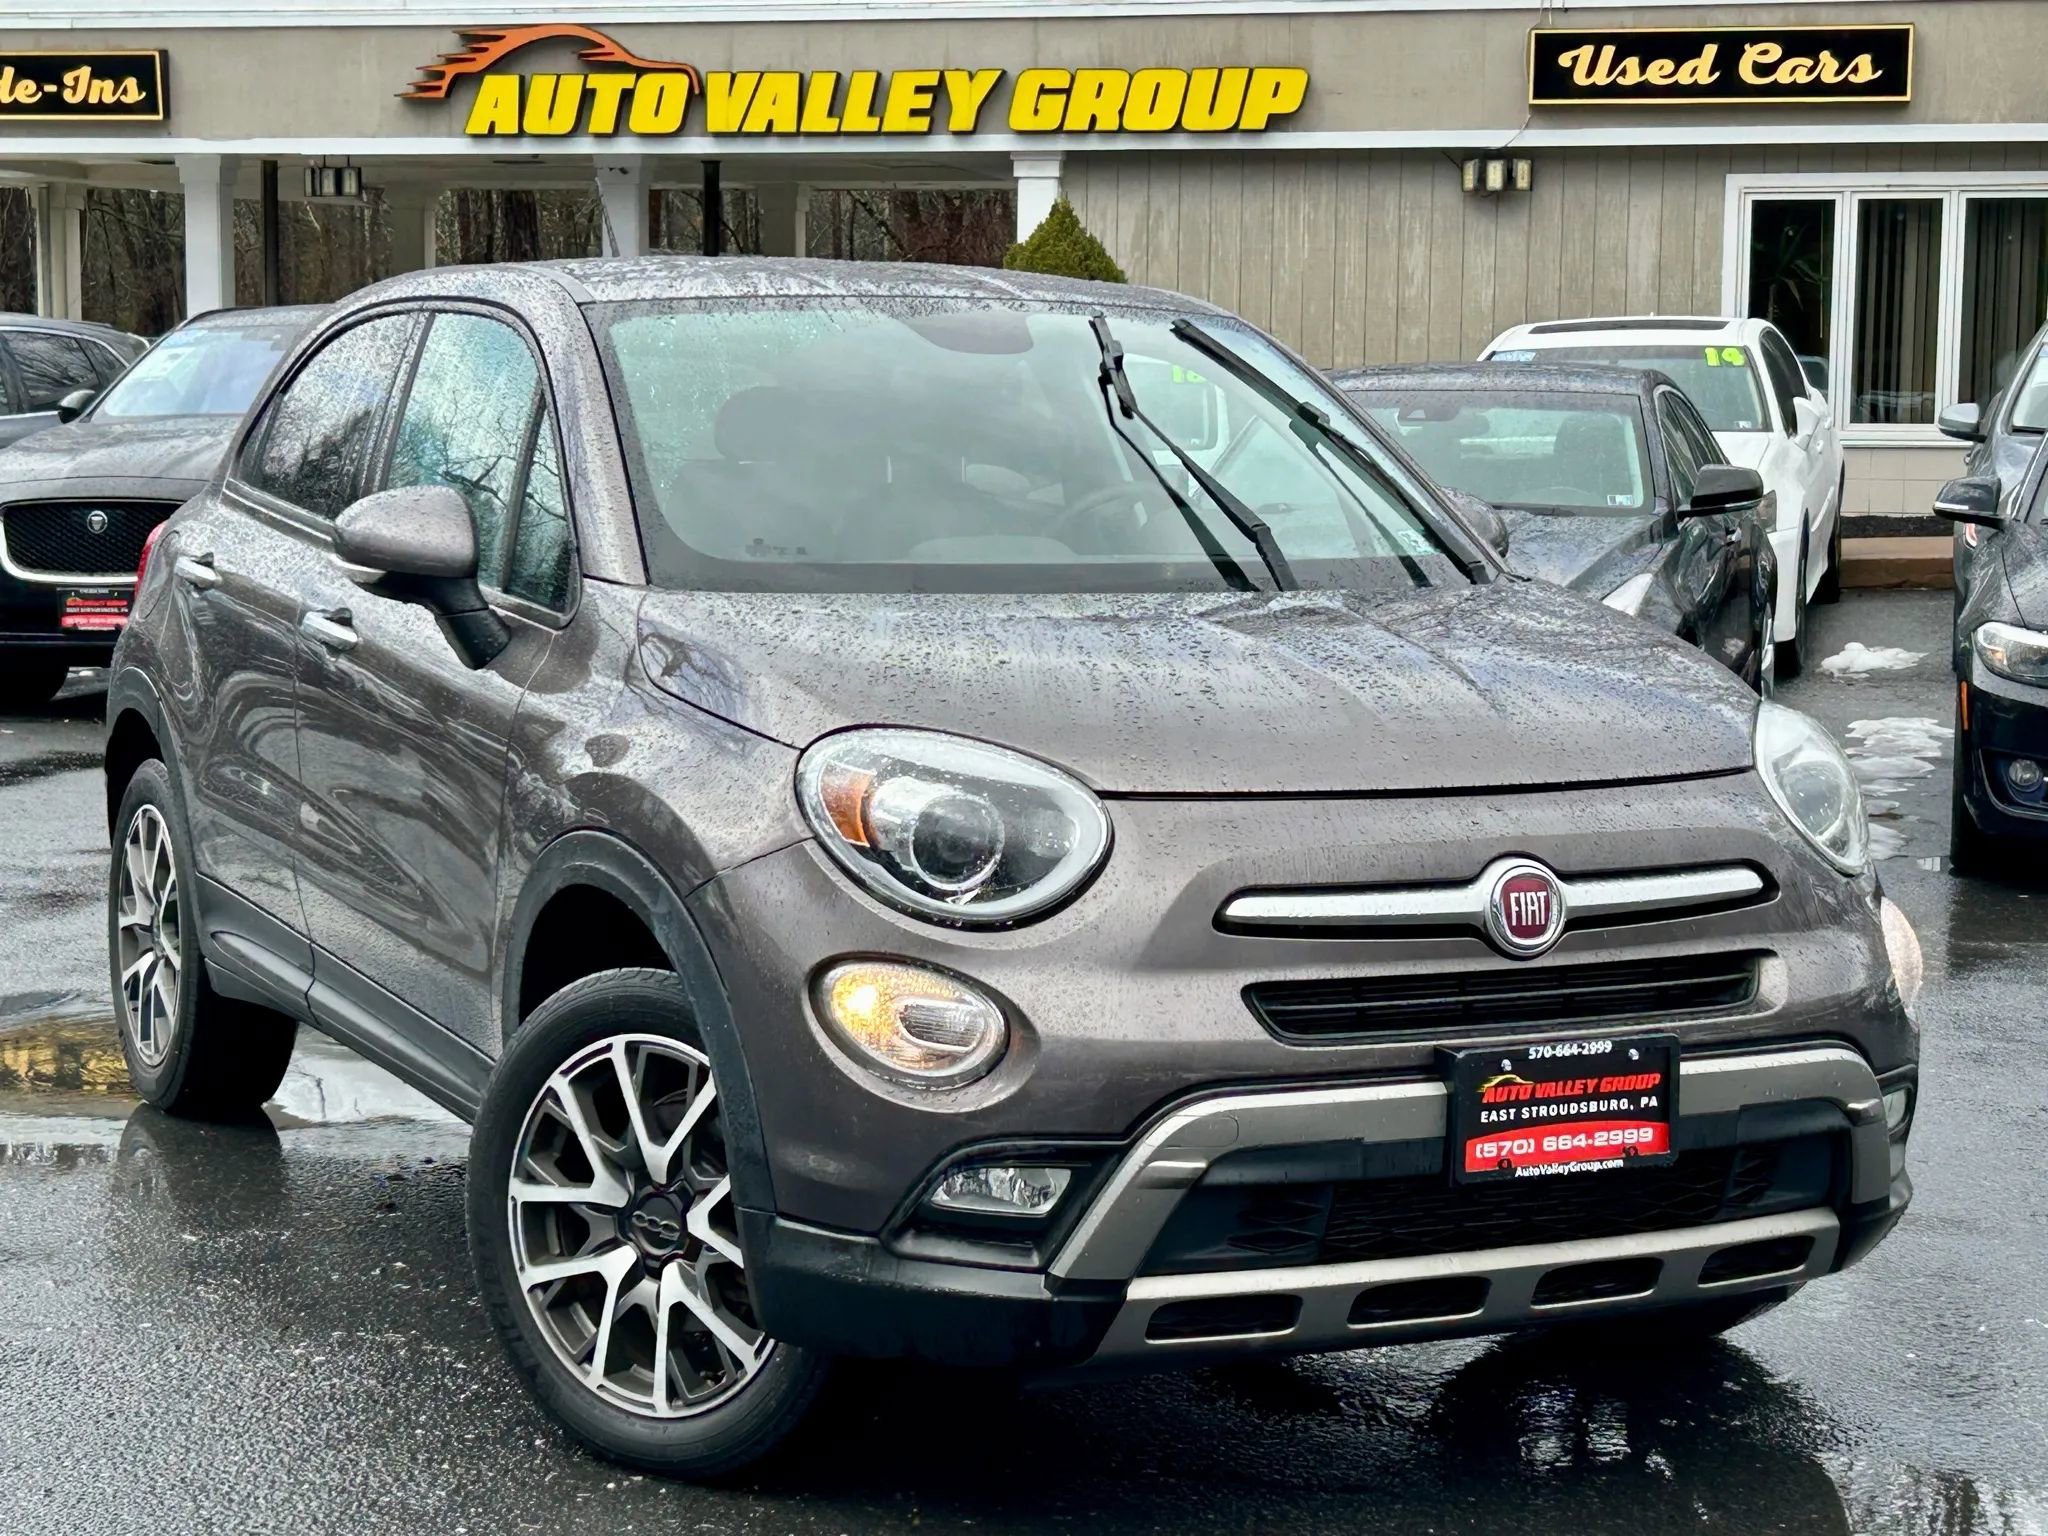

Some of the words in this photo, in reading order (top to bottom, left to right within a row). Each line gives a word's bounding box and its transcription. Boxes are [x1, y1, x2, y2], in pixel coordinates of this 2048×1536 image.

[1558, 43, 1719, 86] Used
[1738, 42, 1882, 85] Cars
[465, 73, 689, 135] AUTO
[706, 68, 1005, 134] VALLEY
[1008, 67, 1308, 133] GROUP
[1509, 891, 1548, 927] FIAT
[1528, 1040, 1613, 1060] 570-664-2999
[1481, 1083, 1534, 1104] AUTO
[1534, 1078, 1599, 1099] VALLEY
[1600, 1072, 1662, 1093] GROUP
[1480, 1108, 1517, 1123] EAST
[1521, 1099, 1634, 1119] STROUDSBURG,
[1640, 1096, 1658, 1108] PA
[1475, 1140, 1535, 1158] (570)
[1515, 1158, 1624, 1178] AutoValleyGroup.com
